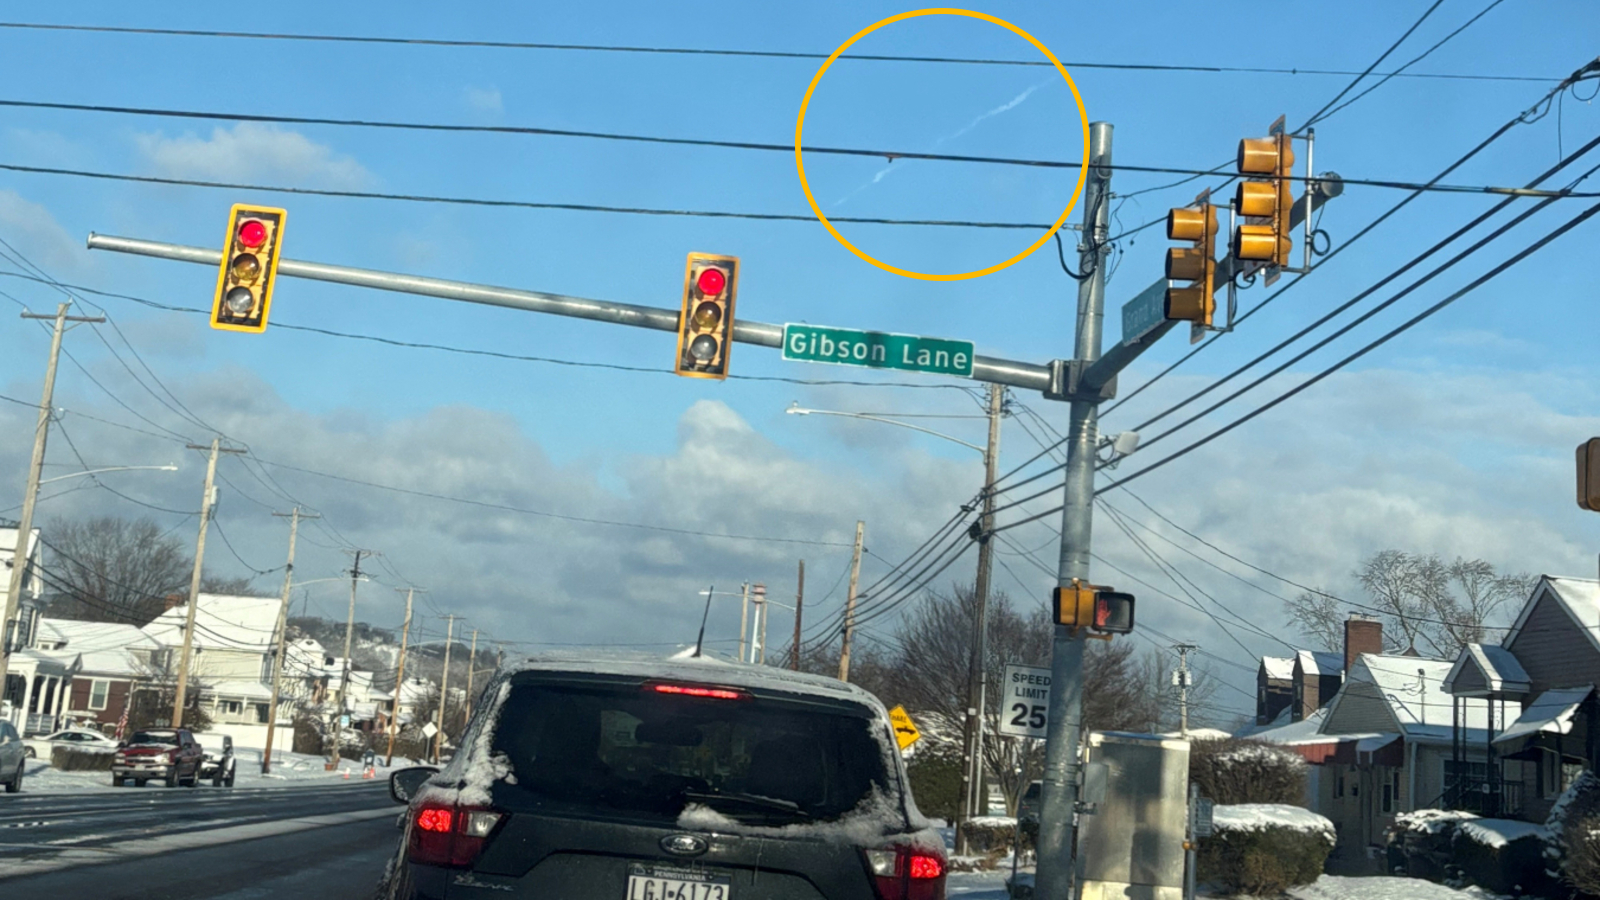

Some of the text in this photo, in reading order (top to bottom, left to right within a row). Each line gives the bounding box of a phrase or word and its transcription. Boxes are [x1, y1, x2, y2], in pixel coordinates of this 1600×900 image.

[790, 333, 968, 370] Gibson Lane
[1012, 672, 1051, 686] SPEED
[1015, 687, 1048, 700] LIMIT
[1010, 703, 1046, 729] 25
[653, 871, 706, 882] PENNSYLVANIA
